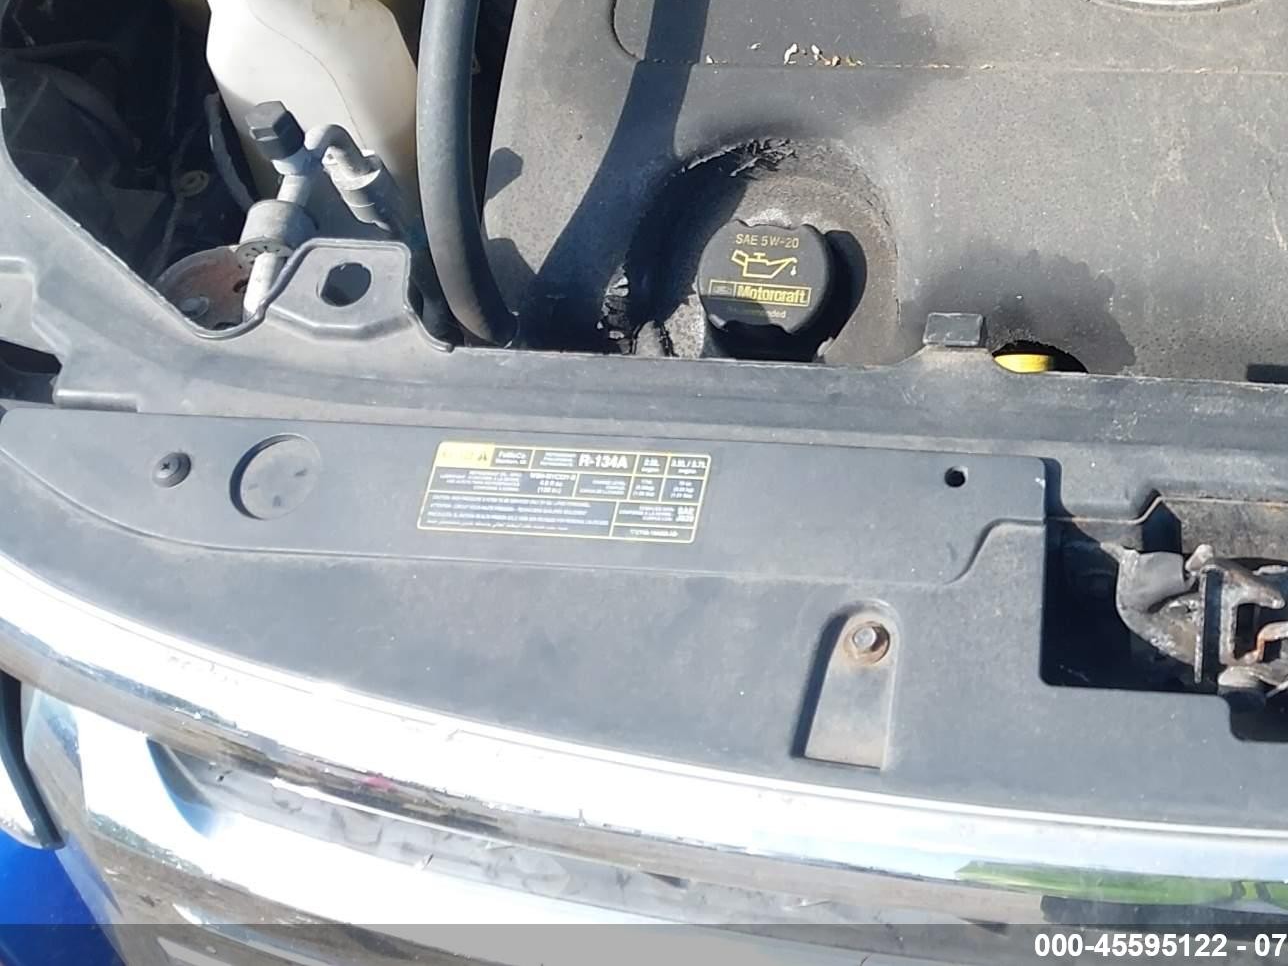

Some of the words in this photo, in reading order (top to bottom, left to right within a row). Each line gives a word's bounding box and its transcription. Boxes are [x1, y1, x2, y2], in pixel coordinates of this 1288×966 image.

[736, 233, 758, 246] SAE
[761, 235, 800, 249] 5W-20
[737, 285, 806, 304] Motorcraft
[578, 453, 629, 469] R-134A
